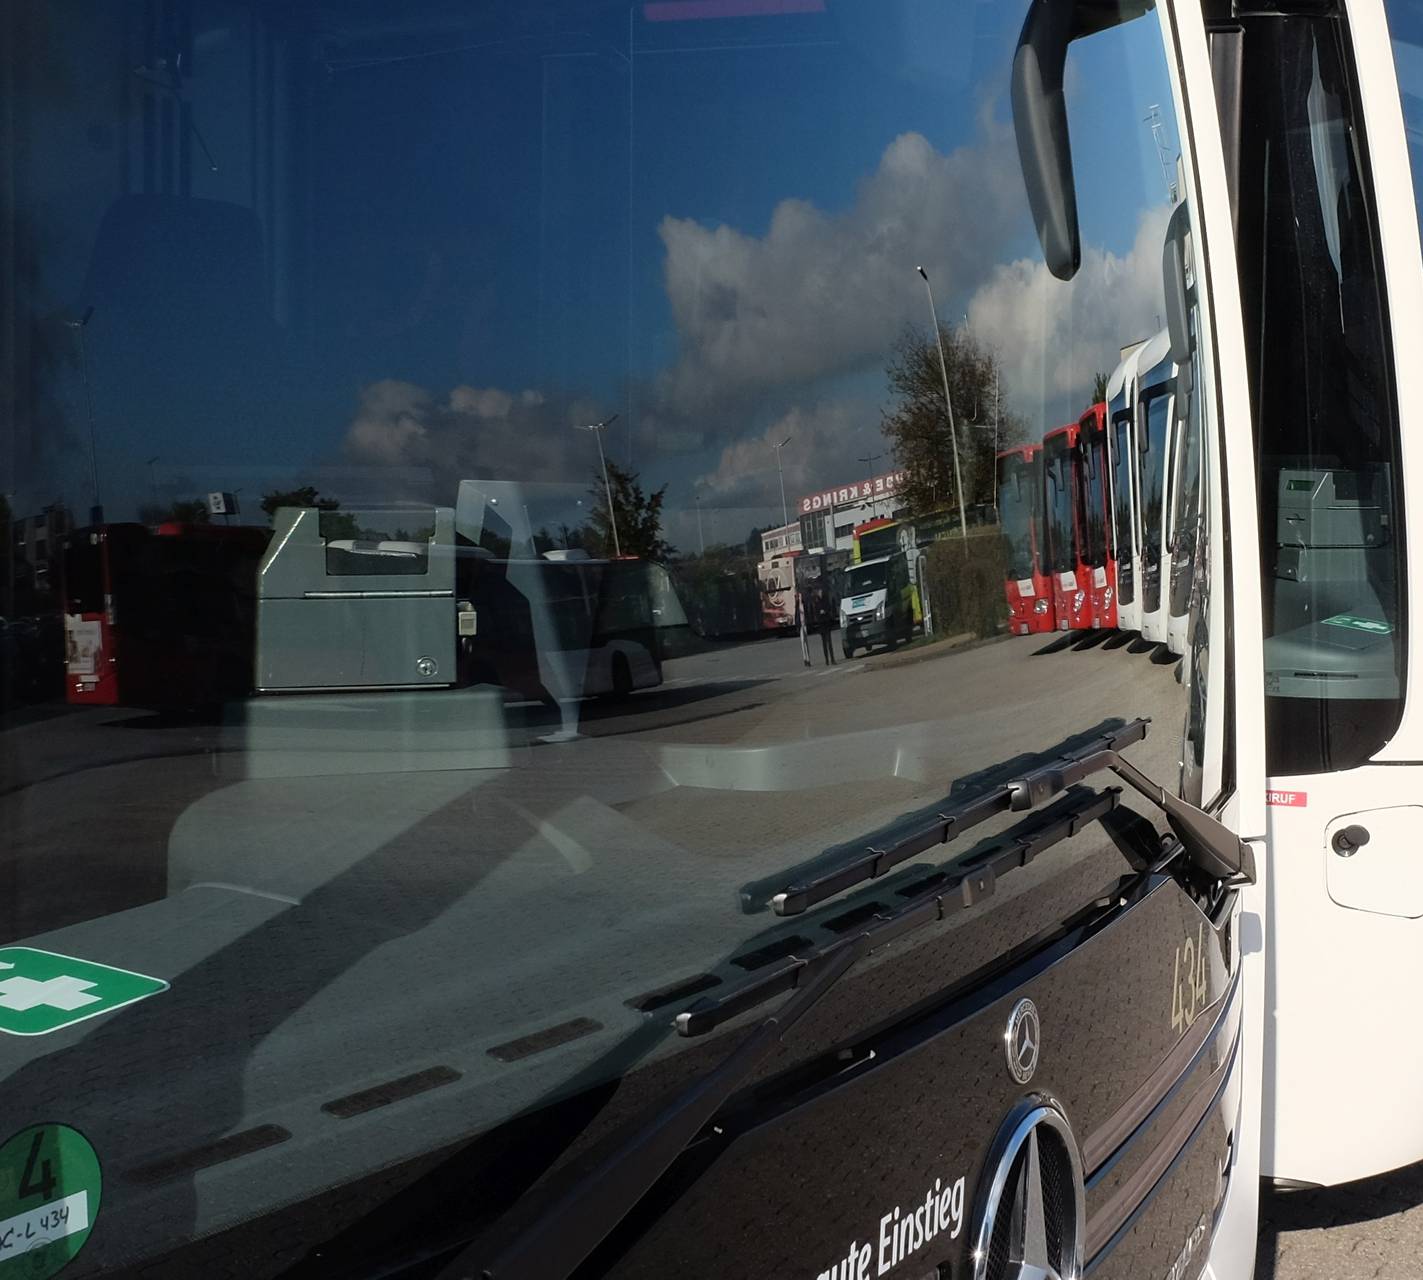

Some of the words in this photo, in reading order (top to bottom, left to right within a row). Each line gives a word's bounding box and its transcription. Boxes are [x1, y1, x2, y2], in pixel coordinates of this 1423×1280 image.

[1266, 792, 1296, 804] IRUF
[1171, 922, 1206, 1034] 434
[18, 1130, 56, 1201] 4
[40, 1206, 70, 1231] 434
[816, 1240, 872, 1280] ute
[878, 1176, 965, 1277] Einstieg
